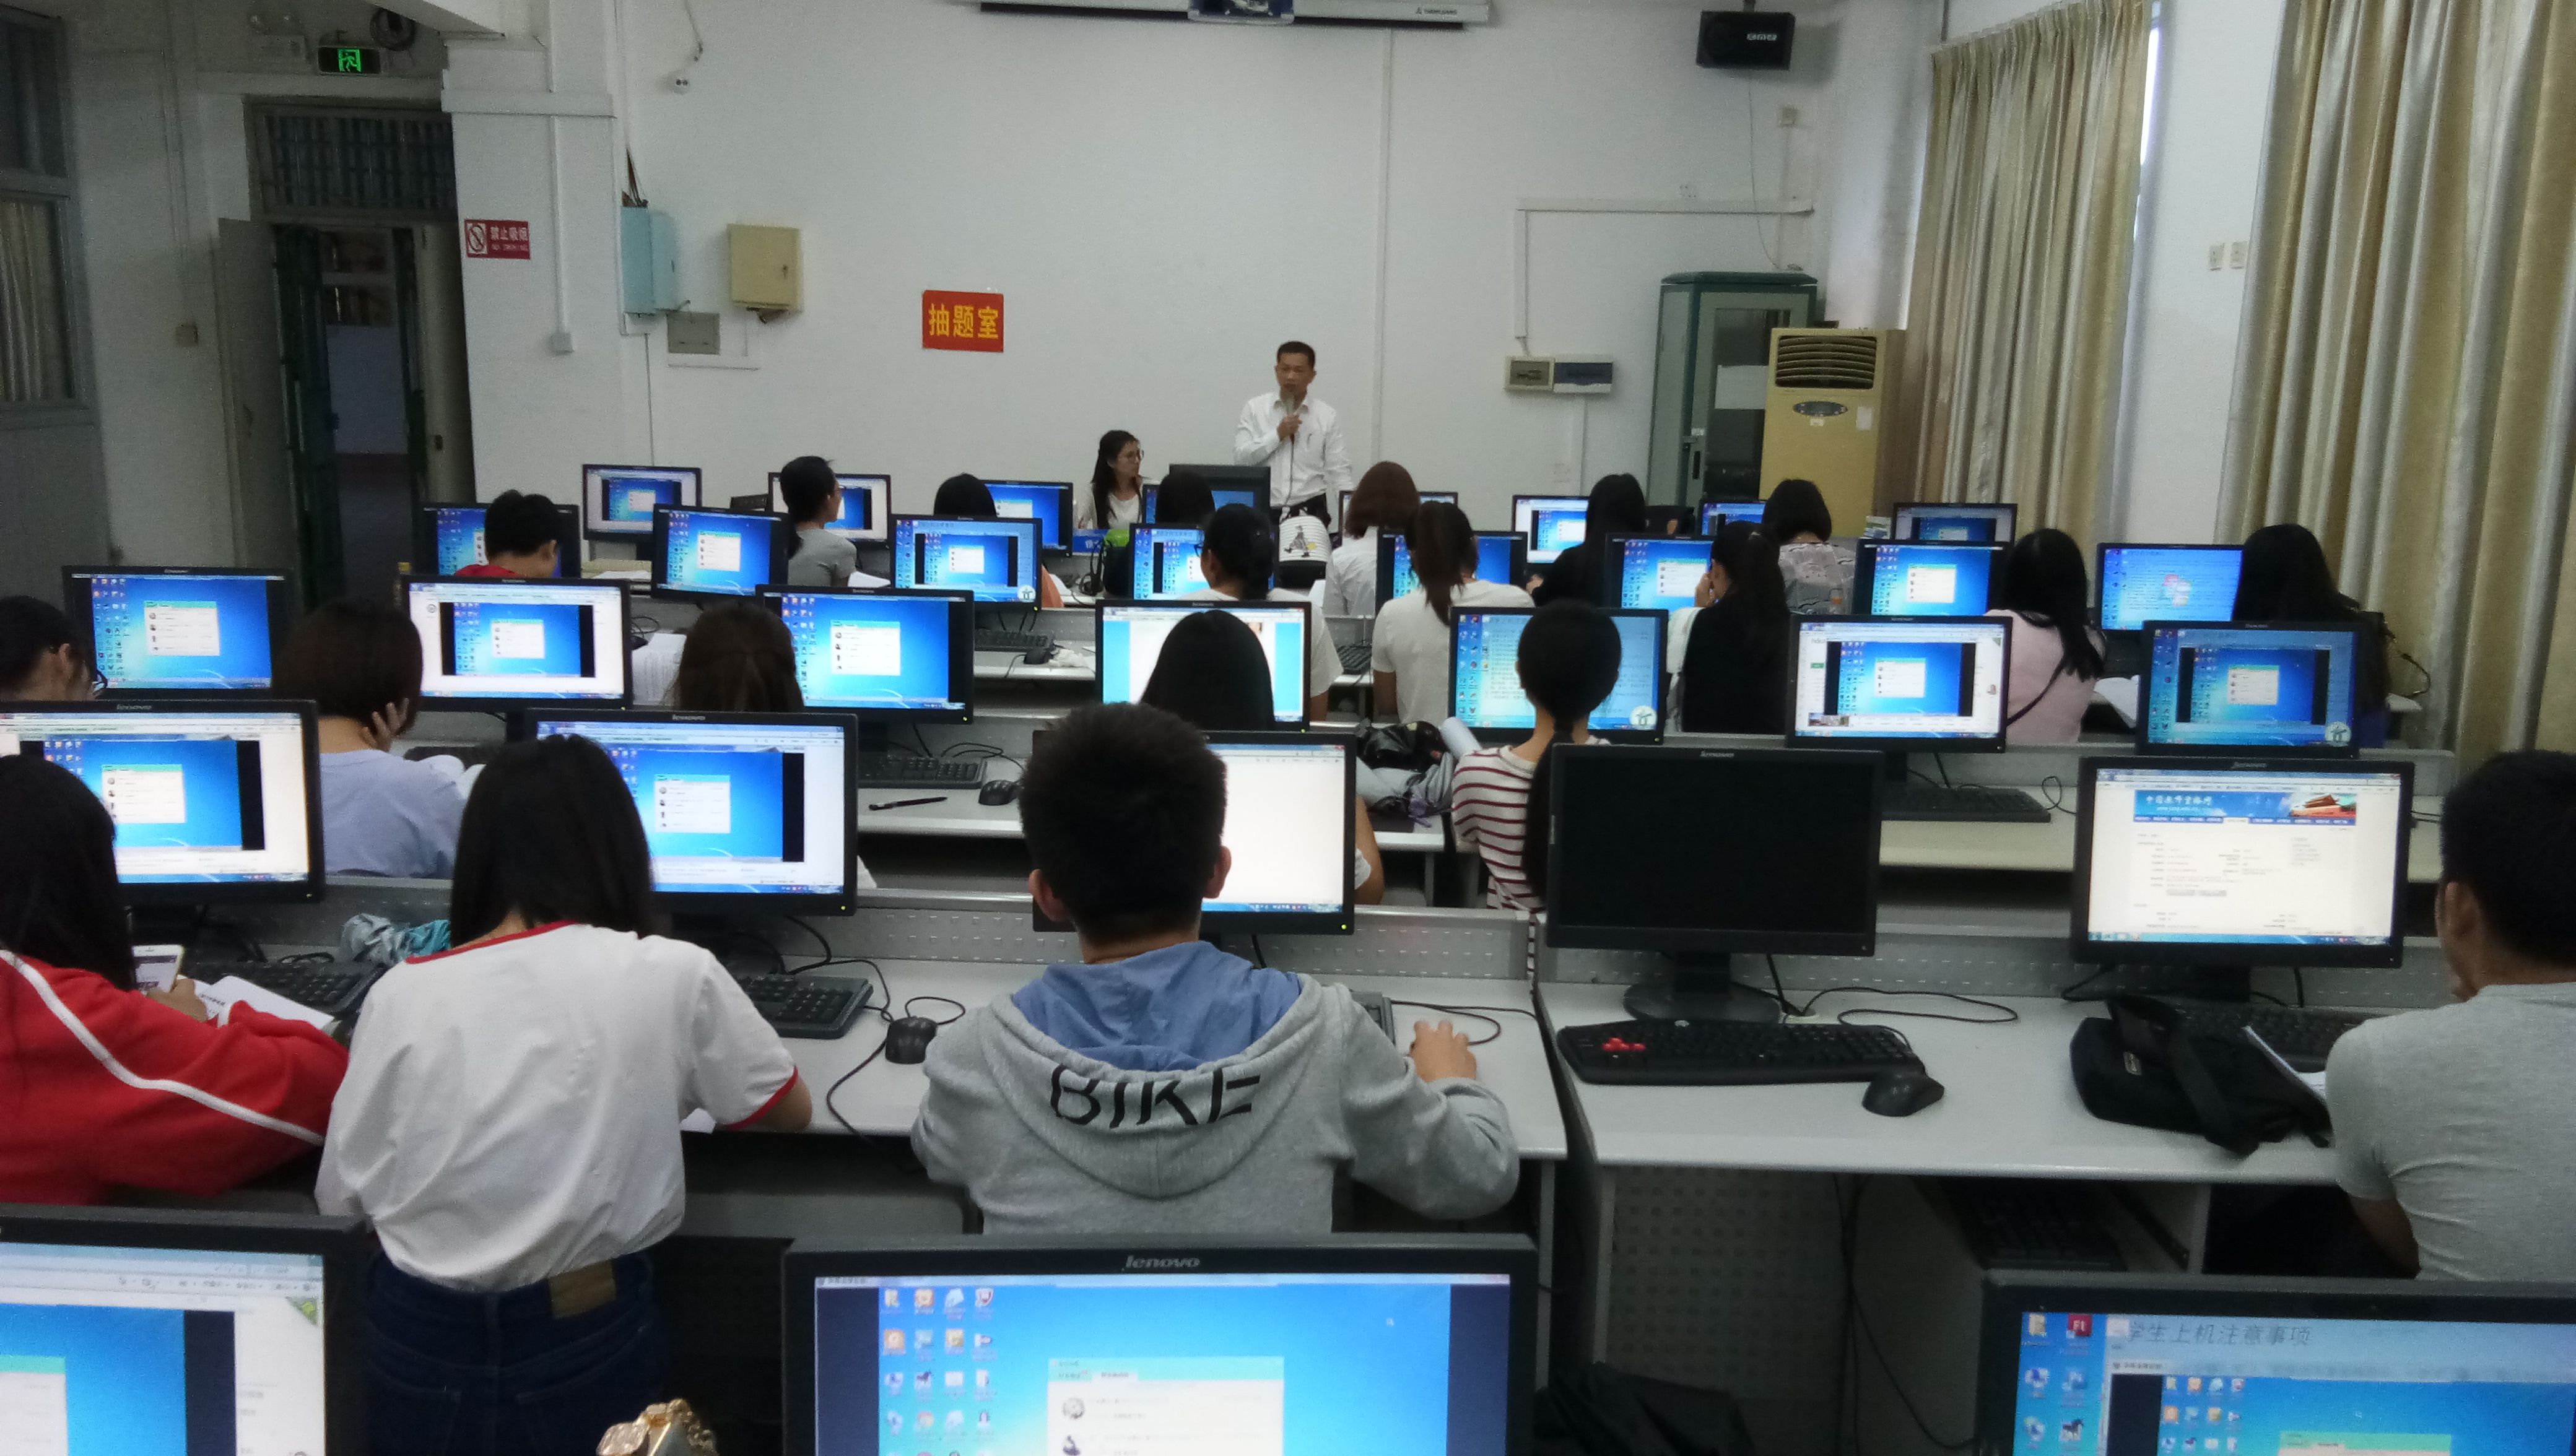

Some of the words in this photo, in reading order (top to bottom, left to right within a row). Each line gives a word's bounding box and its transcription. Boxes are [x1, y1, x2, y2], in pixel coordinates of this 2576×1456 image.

[928, 303, 999, 339] 抽题室
[1051, 1064, 1261, 1129] BIKE
[1125, 1255, 1201, 1268] lenovo
